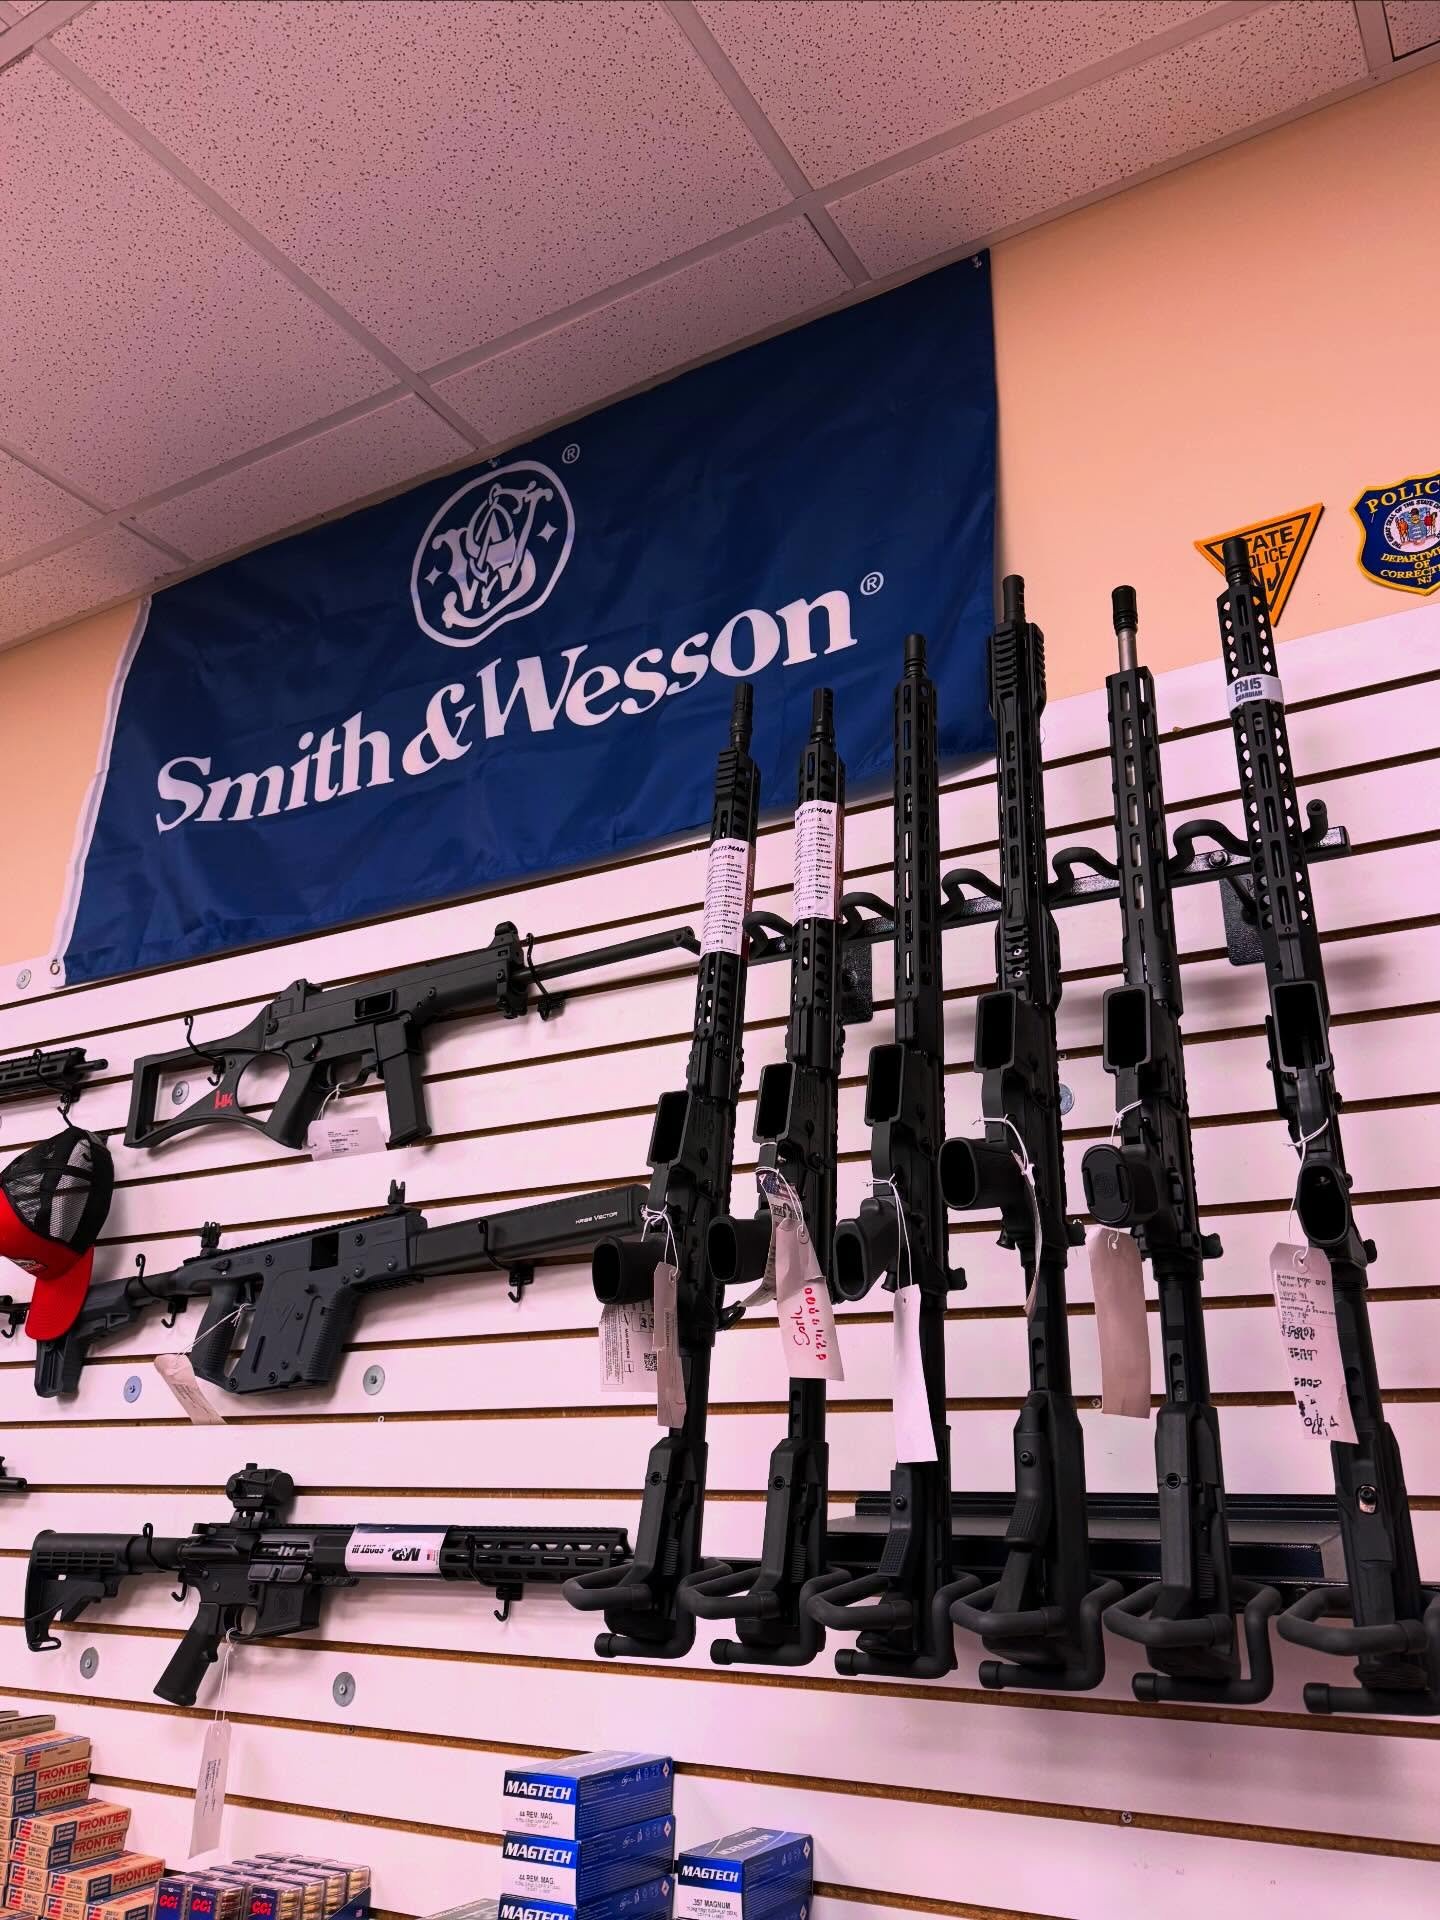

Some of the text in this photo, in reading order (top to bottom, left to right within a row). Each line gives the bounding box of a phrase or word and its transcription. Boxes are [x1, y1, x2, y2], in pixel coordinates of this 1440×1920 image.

[1246, 526, 1294, 553] ATE
[1249, 545, 1289, 568] OLICE
[1381, 546, 1440, 563] DEPARTM
[1414, 560, 1431, 569] OF
[1380, 564, 1440, 579] CORRECT
[1417, 576, 1432, 585] NJ
[156, 591, 857, 833] Smith & Wesson
[38, 1761, 88, 1782] FRONTIER
[38, 1782, 88, 1802] FRONTIER
[506, 1780, 571, 1800] MAGTECH
[78, 1811, 129, 1832] FRONTIER
[73, 1831, 124, 1854] FRONTIER
[505, 1842, 572, 1864] MAGTECH
[113, 1862, 163, 1886] FRONTIER
[682, 1865, 739, 1883] MAGTECH
[704, 1900, 731, 1910] MAGNUM
